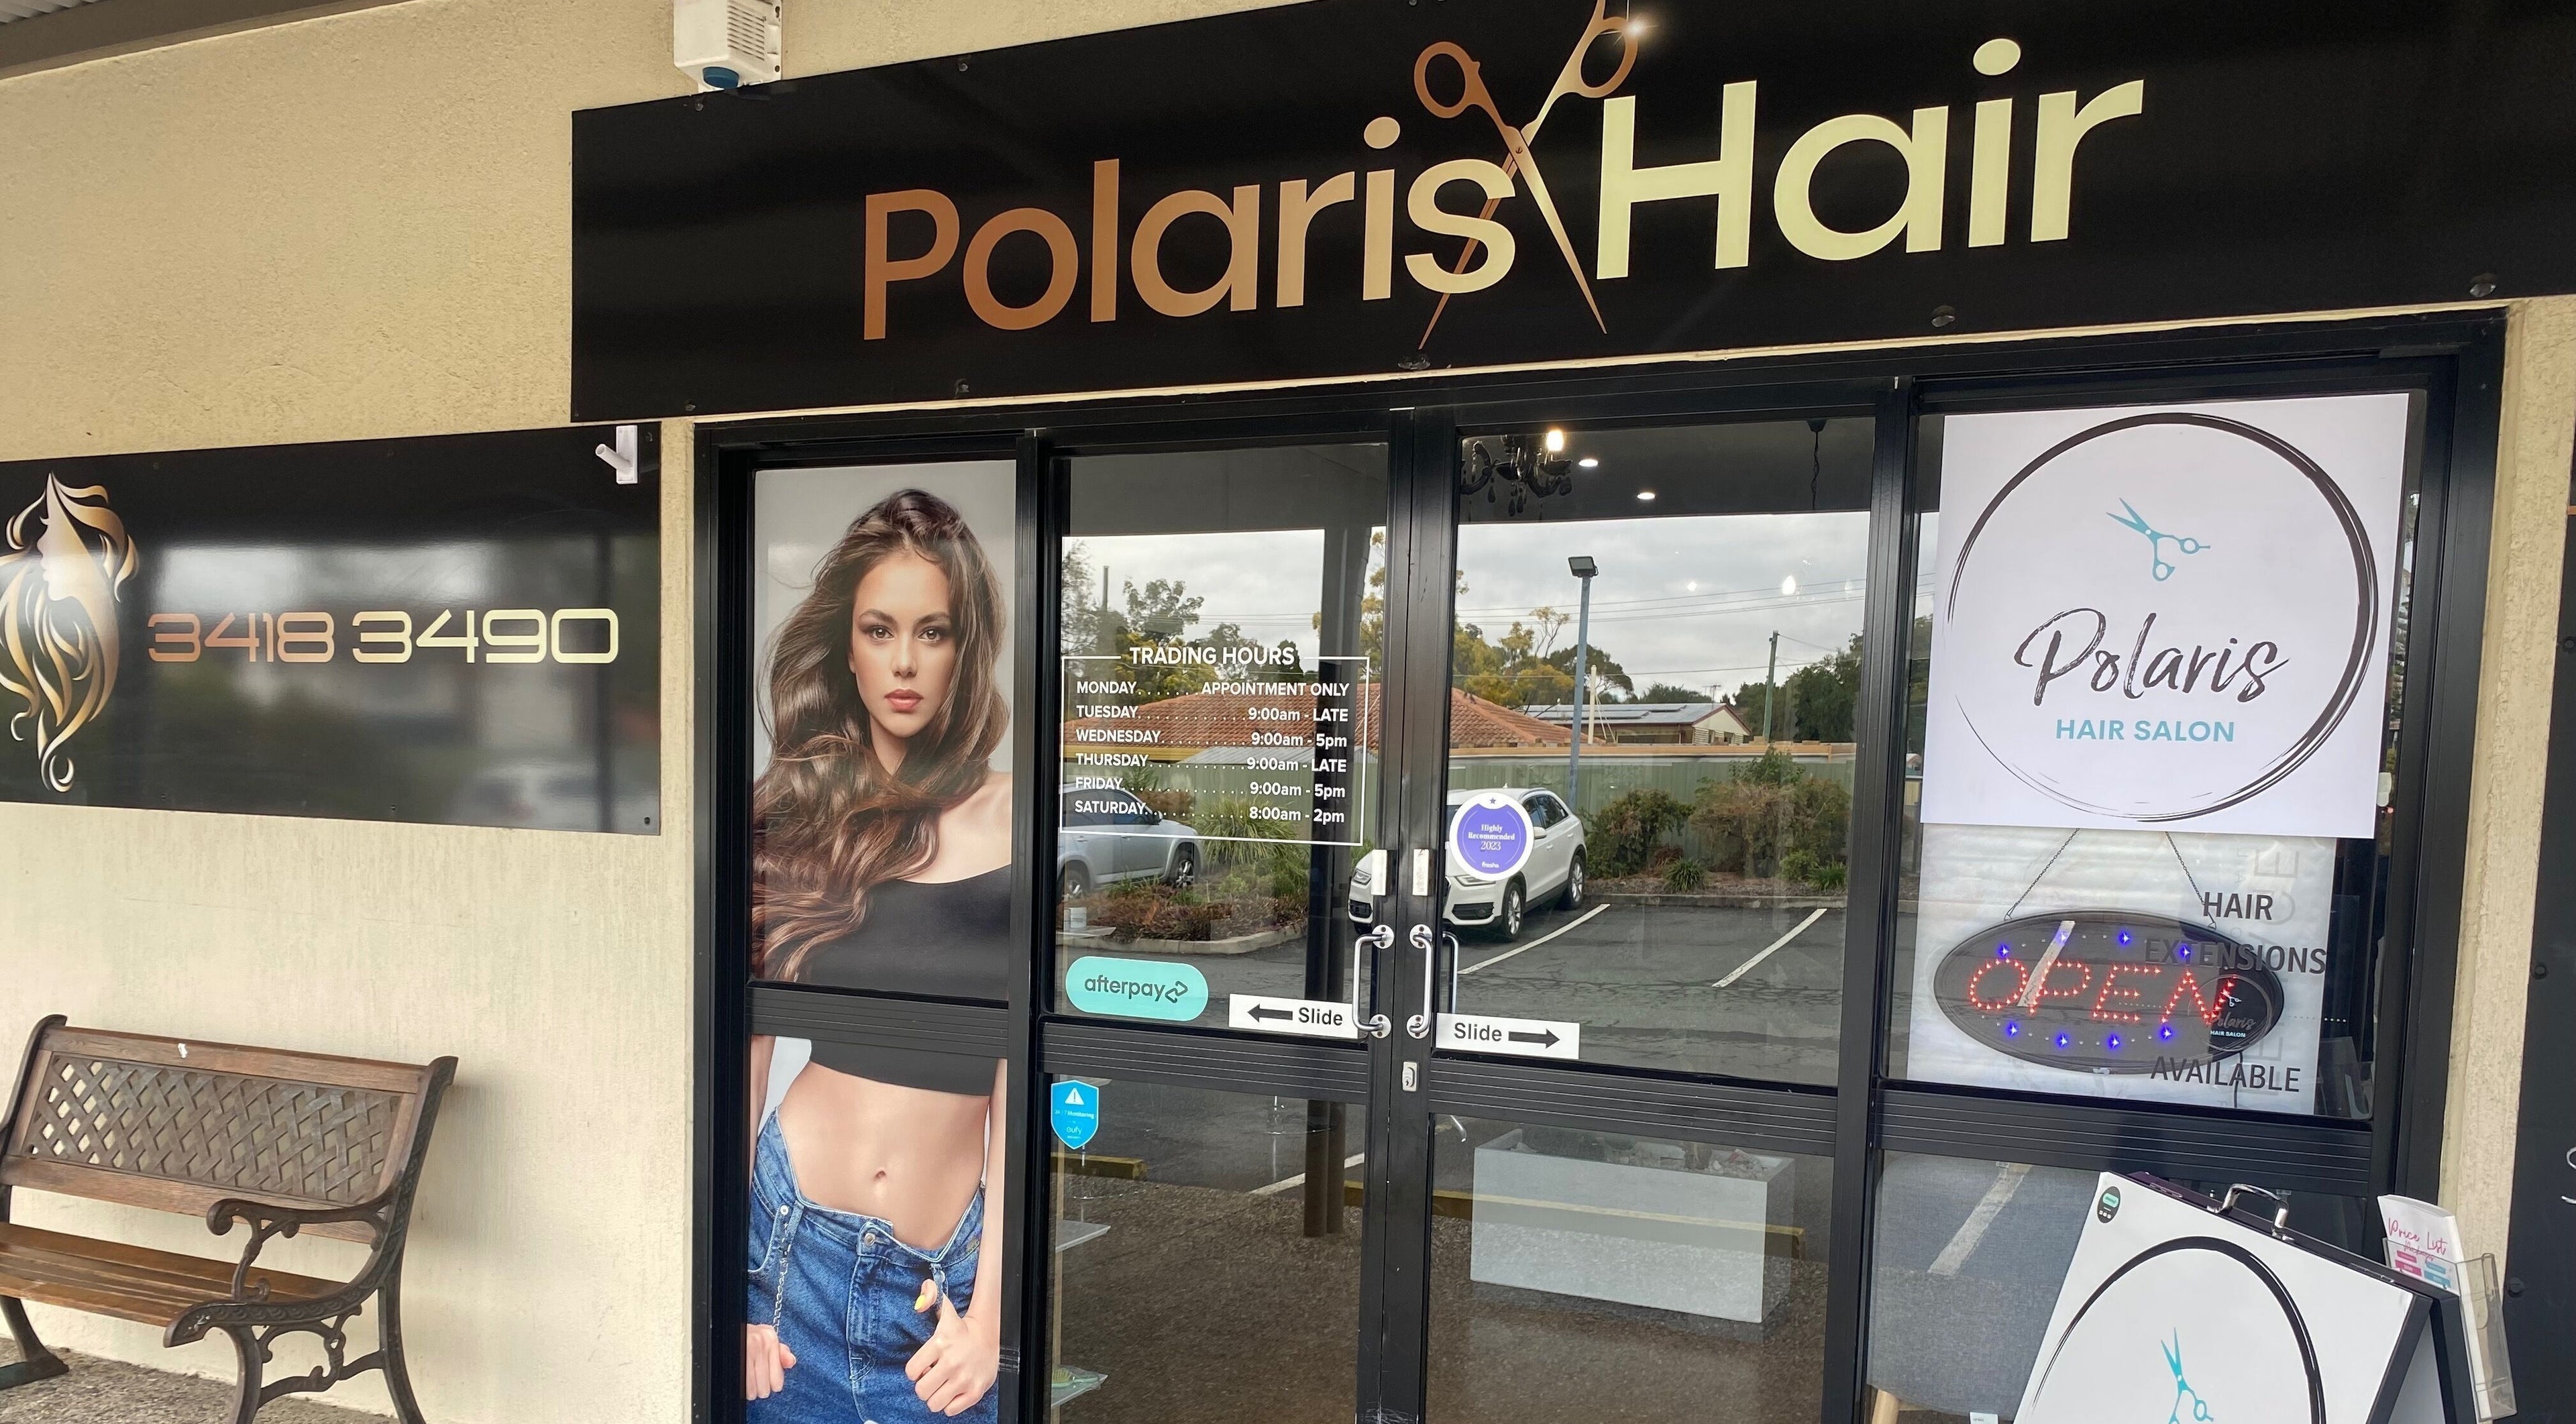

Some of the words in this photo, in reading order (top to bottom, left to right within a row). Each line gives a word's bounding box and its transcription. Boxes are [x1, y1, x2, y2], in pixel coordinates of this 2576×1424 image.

[863, 116, 1516, 341] Polaris
[1595, 38, 2144, 280] Hair
[148, 612, 335, 663] 3418
[352, 608, 619, 664] 3490
[1129, 647, 1217, 665] TRADING
[1222, 647, 1295, 666] HOURS
[2013, 607, 2292, 706] Polaris
[1077, 681, 1136, 694] MONDAY
[1201, 682, 1306, 696] APPOINTMENT
[1310, 683, 1350, 698] ONLY
[1077, 705, 1138, 718] TUESDAY
[1248, 707, 1300, 721] 9:00am
[1313, 708, 1348, 722] LATE
[1076, 729, 1161, 743] WEDNESDAY
[1251, 732, 1303, 746] 9:00am
[1316, 734, 1347, 750] 5pm
[2055, 719, 2124, 741] HAIR
[2134, 720, 2235, 743] SALON
[1076, 753, 1149, 767] THURSDAY
[1246, 757, 1299, 771] 9:00am
[1311, 759, 1347, 773] LATE
[1075, 777, 1124, 790] FRIDAY
[1250, 782, 1302, 797] 9:00am
[1314, 783, 1346, 800] 5pm
[1075, 801, 1146, 815] SATURDAY
[1249, 806, 1301, 821] 8:00am
[1313, 808, 1344, 825] 2pm
[1468, 832, 1515, 840] Recommended
[1481, 824, 1503, 833] Highly
[1481, 840, 1501, 851] 2023
[2202, 892, 2272, 920] HAIR
[2145, 939, 2326, 975] EXTENSIONS
[1084, 974, 1165, 1001] afterpay
[1969, 954, 2238, 1025] OPEN
[1298, 1007, 1343, 1026] Slide
[1454, 1023, 1502, 1042] Slide
[2150, 1056, 2301, 1092] AVAILABLE
